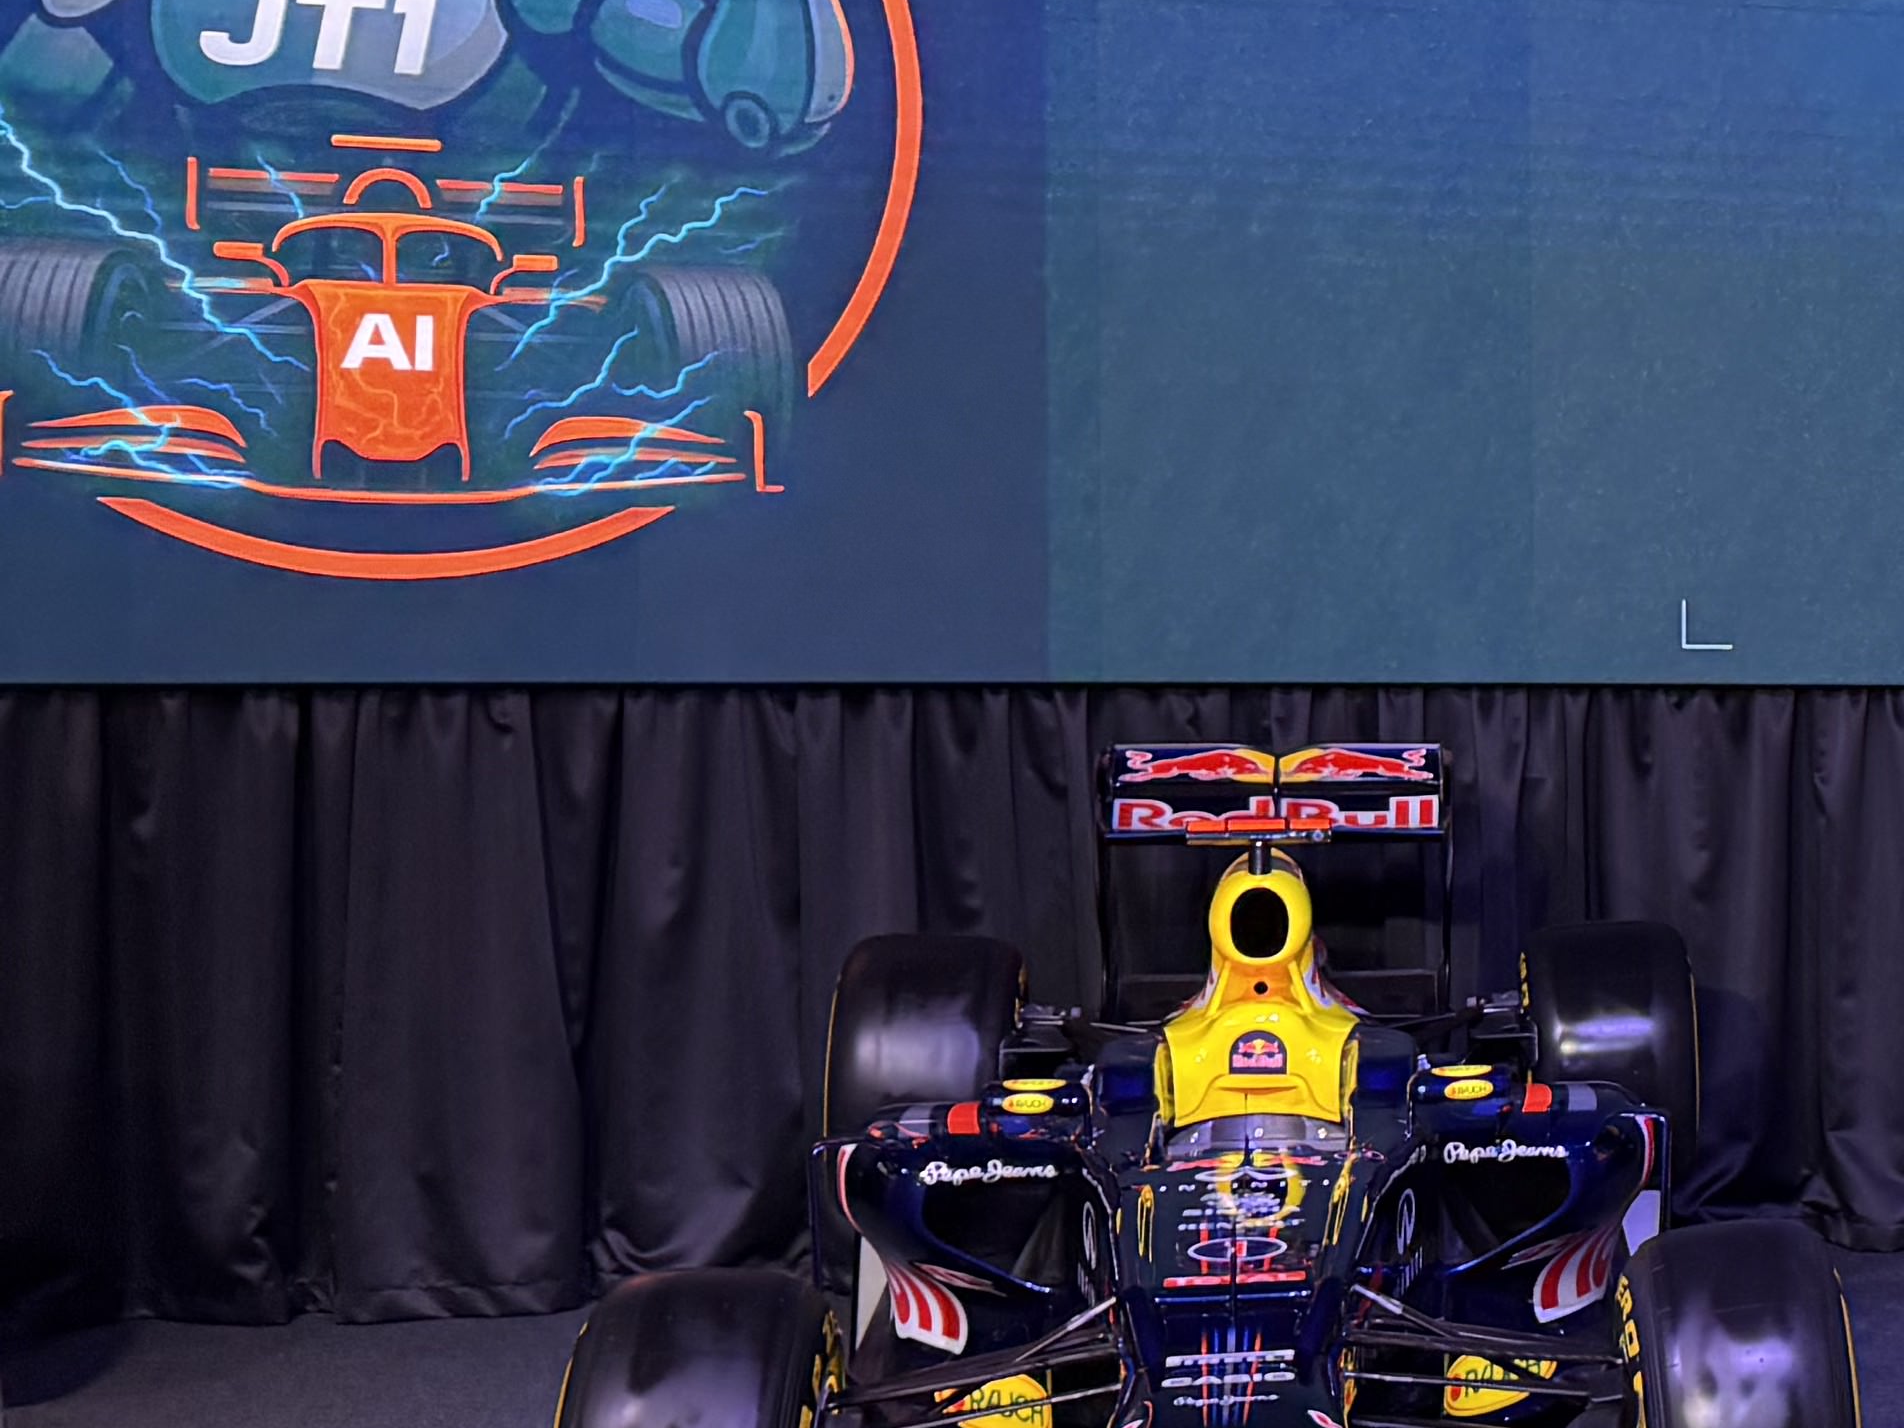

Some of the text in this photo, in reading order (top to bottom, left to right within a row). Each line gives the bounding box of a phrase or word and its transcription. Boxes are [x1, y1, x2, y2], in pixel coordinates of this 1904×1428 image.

[340, 312, 434, 372] AI
[1498, 1139, 1569, 1162] Jeans
[982, 1159, 1059, 1183] Jeans
